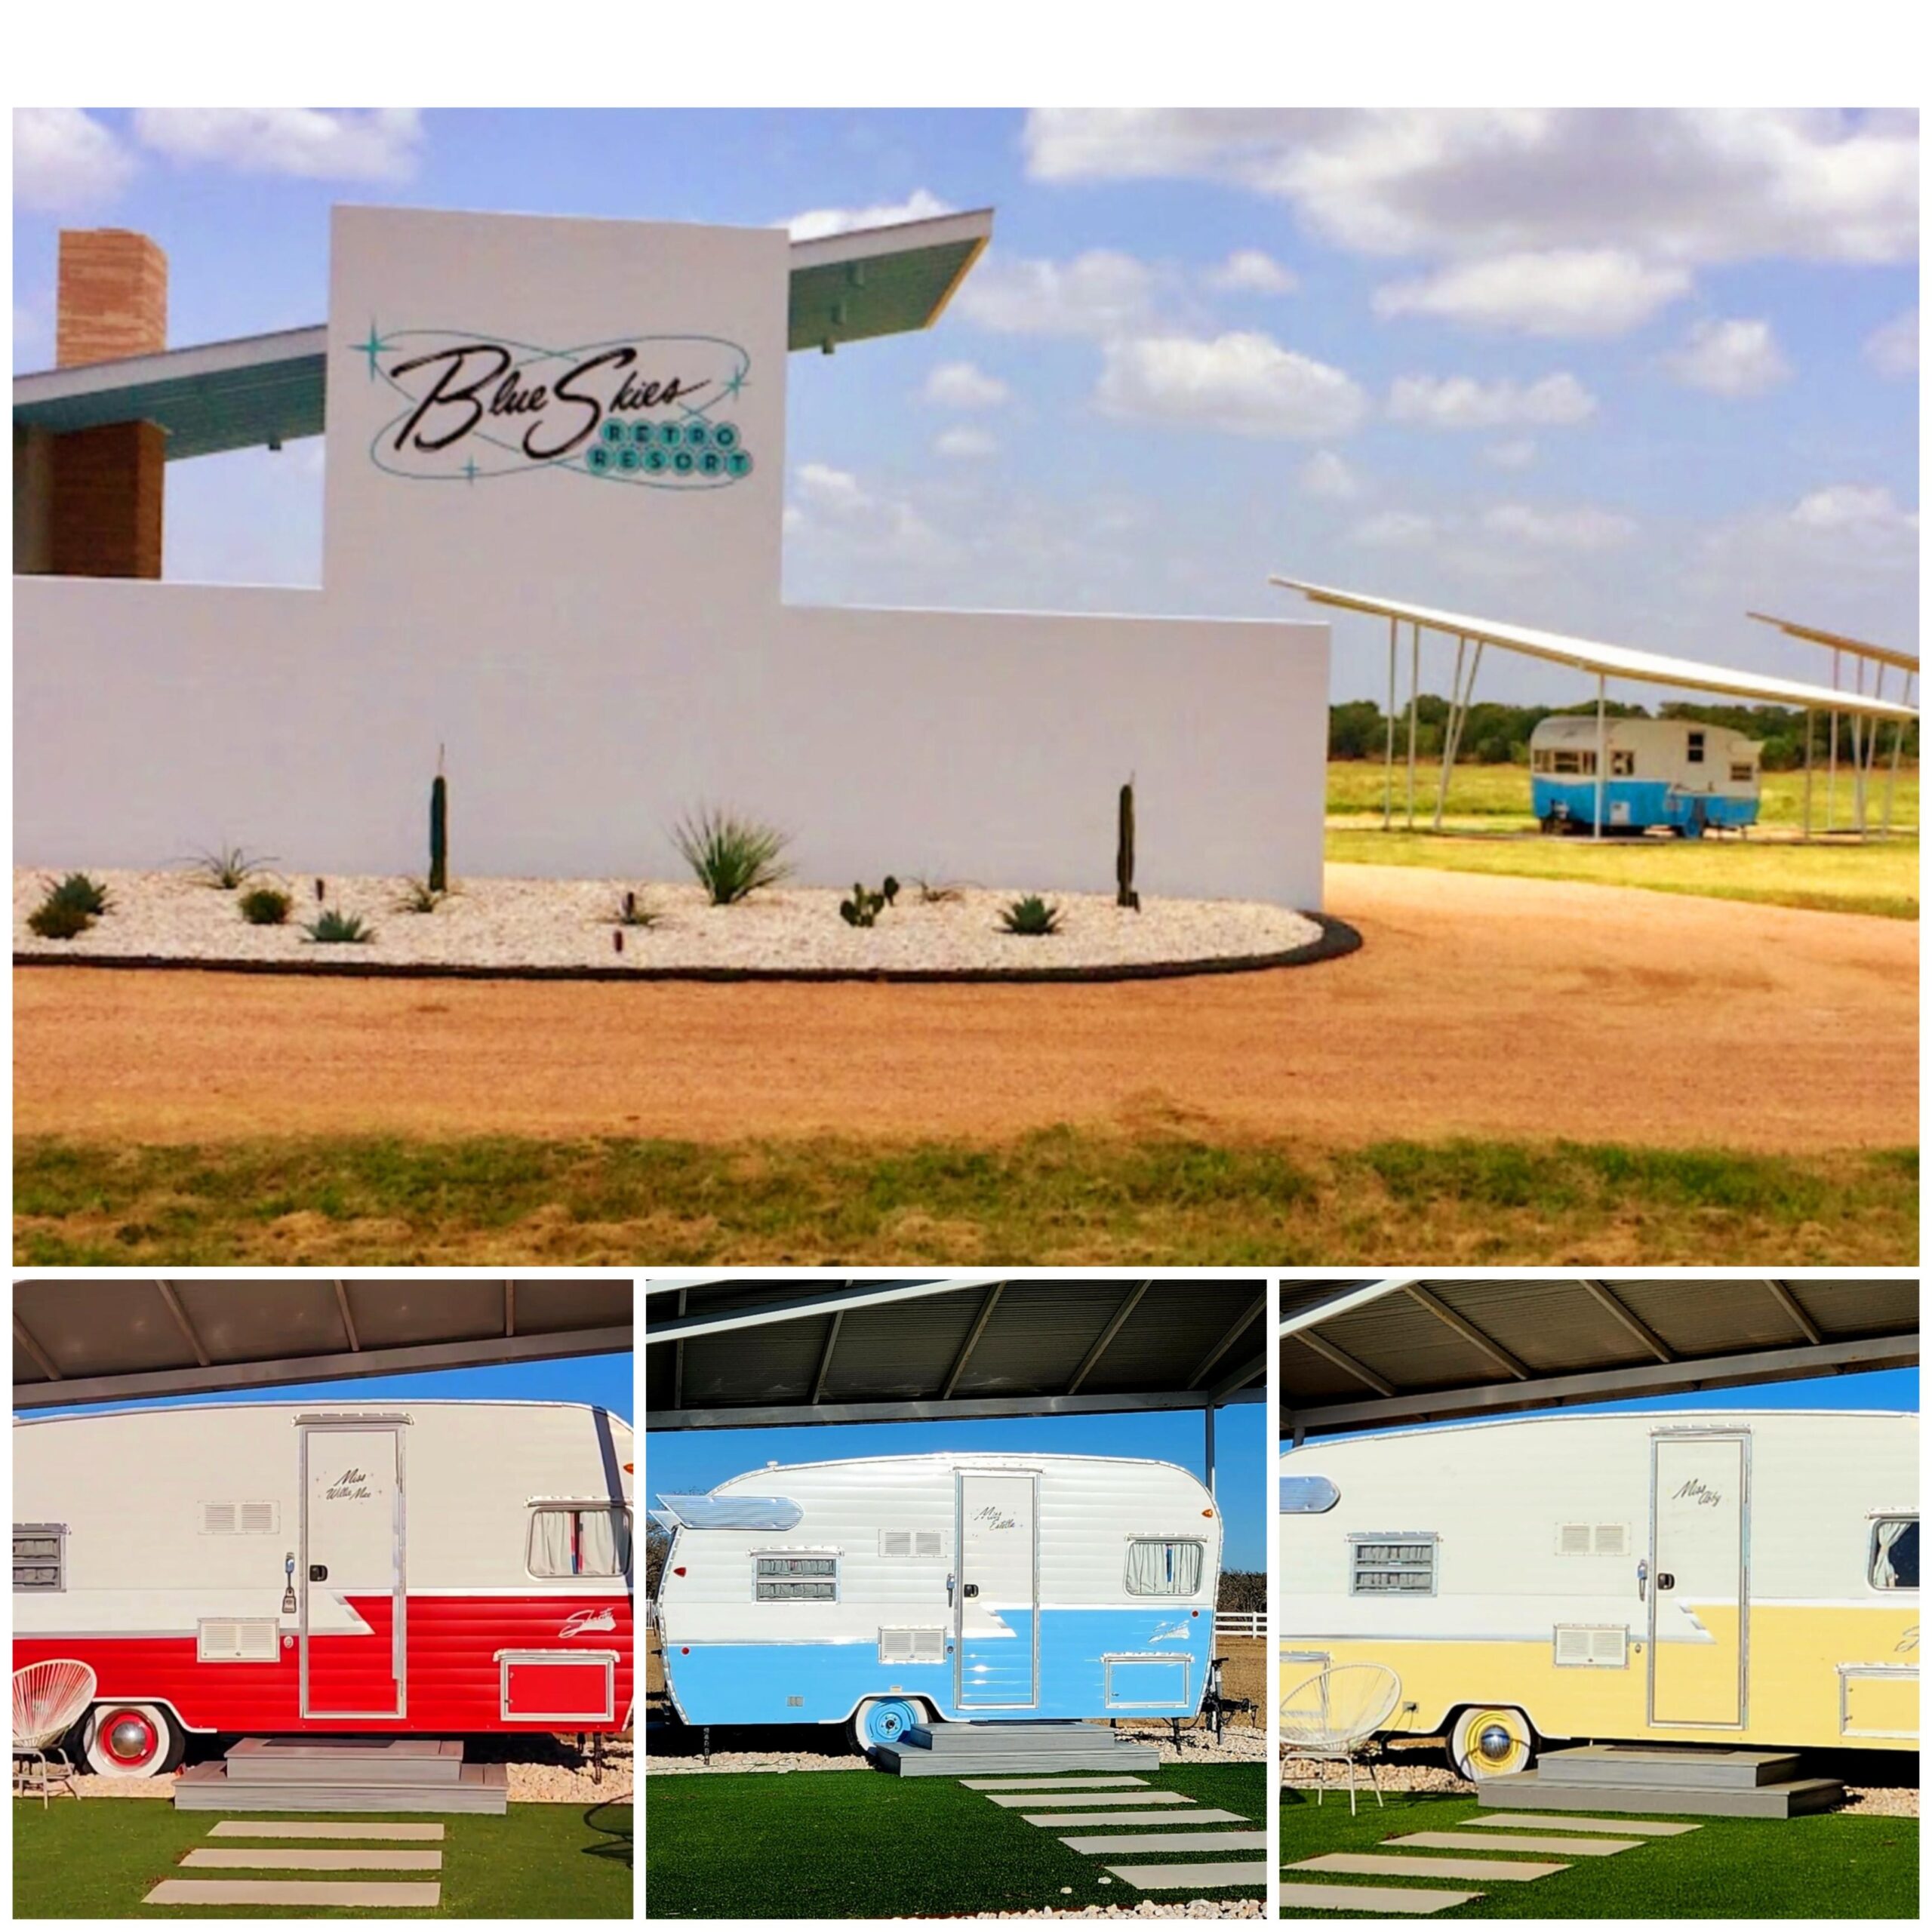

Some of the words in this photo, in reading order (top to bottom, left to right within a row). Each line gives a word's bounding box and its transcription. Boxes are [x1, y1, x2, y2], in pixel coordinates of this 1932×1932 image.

[390, 344, 548, 451] Blue
[522, 347, 712, 459] Skies
[605, 422, 737, 448] RETRO
[592, 450, 746, 472] RESORT
[334, 1468, 366, 1487] Miss
[1671, 1478, 1706, 1500] Miss
